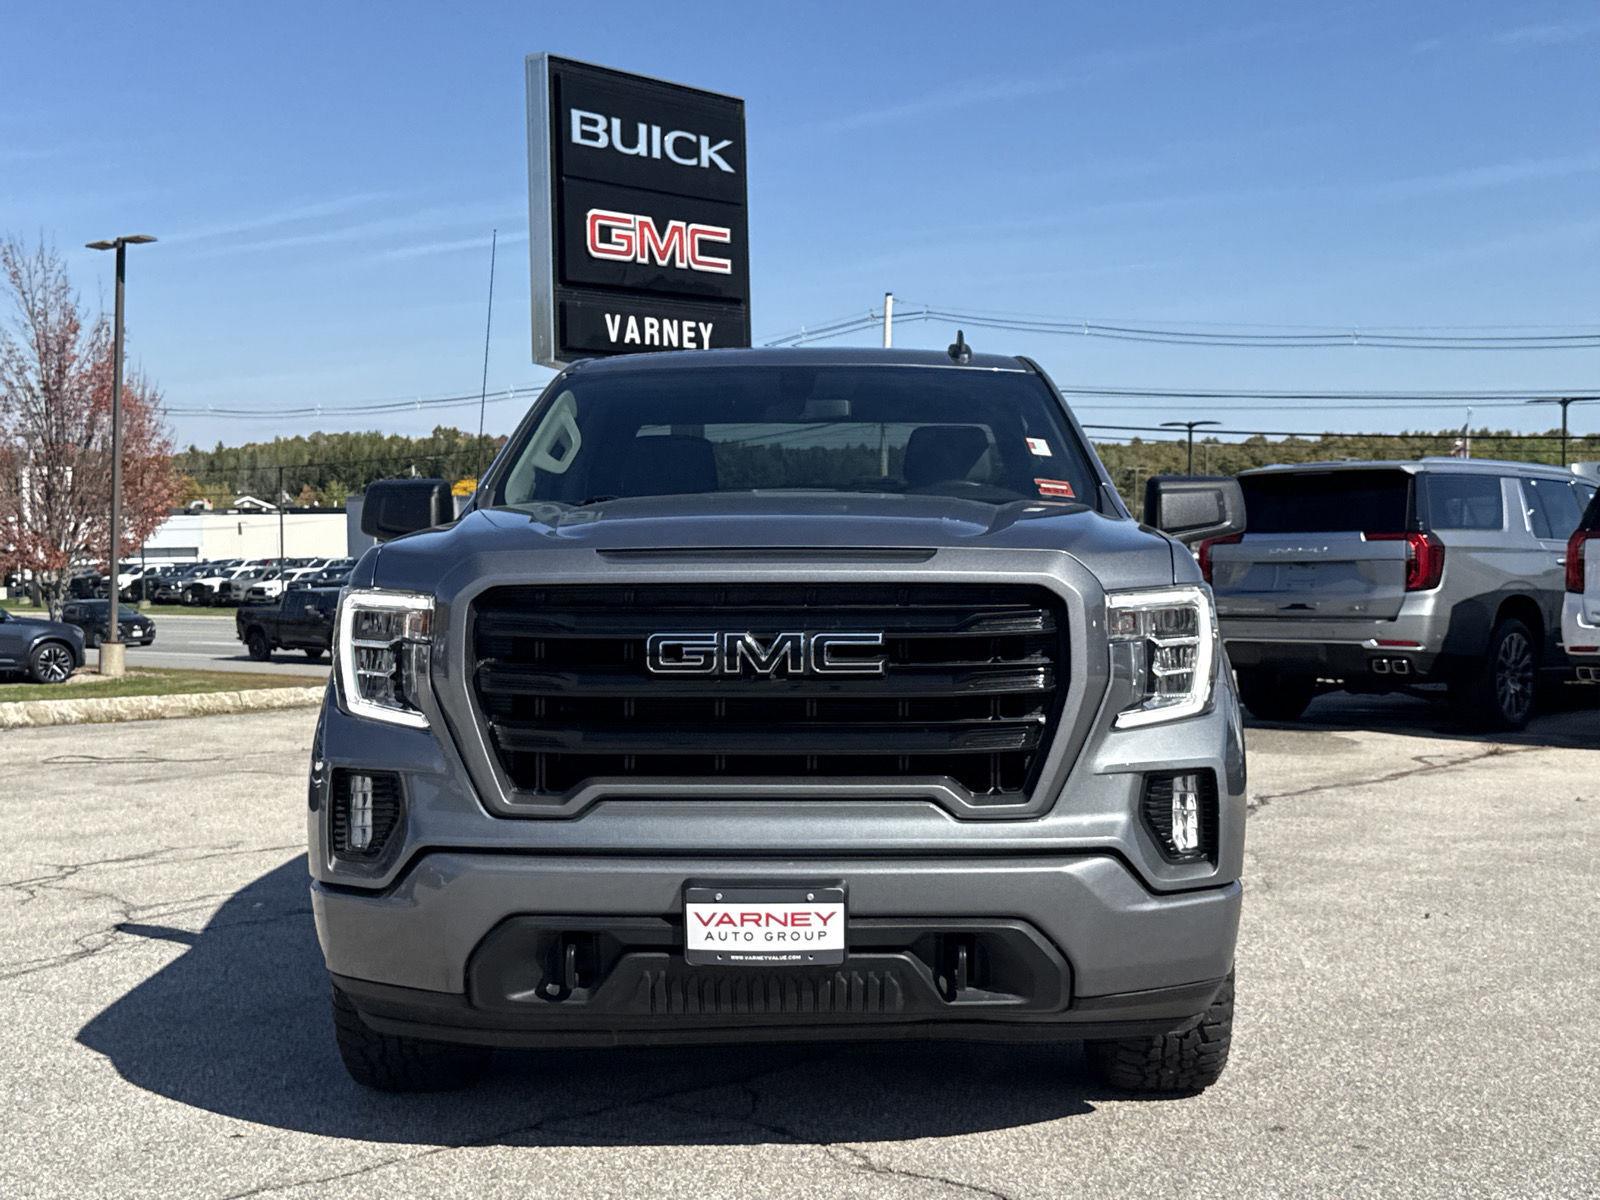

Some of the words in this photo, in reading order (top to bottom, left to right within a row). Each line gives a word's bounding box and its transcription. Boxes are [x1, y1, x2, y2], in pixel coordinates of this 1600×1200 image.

[570, 108, 736, 174] BUICK
[586, 208, 732, 275] GMC
[605, 313, 714, 350] VARNEY
[646, 631, 885, 675] GMC
[694, 911, 837, 928] VARNEY
[704, 931, 755, 942] AUTO
[764, 931, 828, 942] GROUP
